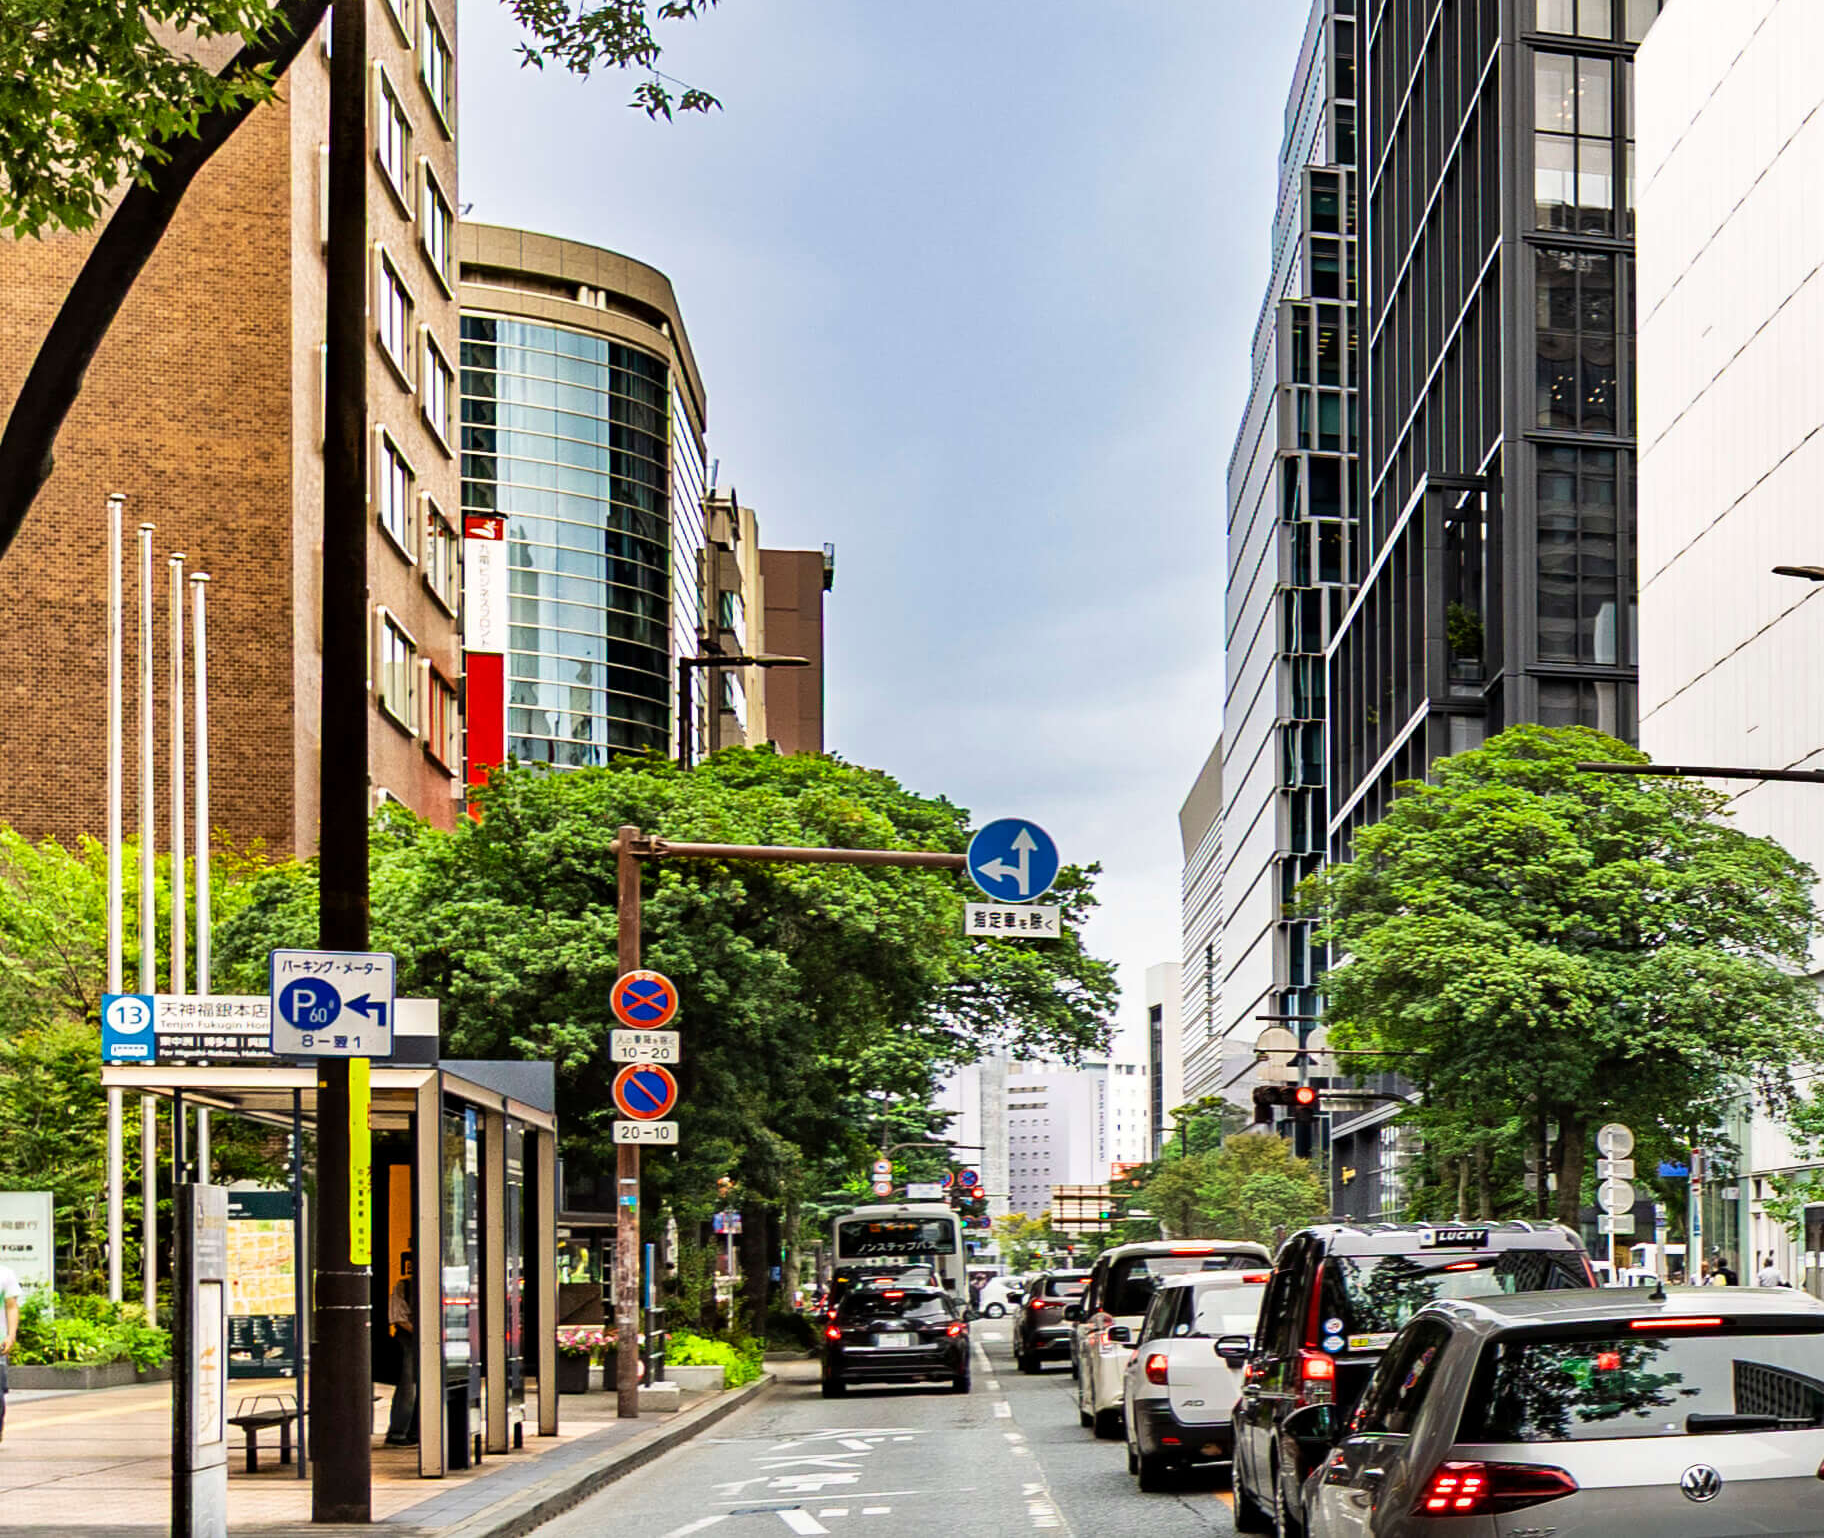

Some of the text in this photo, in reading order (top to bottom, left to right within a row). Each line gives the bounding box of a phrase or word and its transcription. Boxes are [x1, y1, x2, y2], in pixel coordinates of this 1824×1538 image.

[974, 911, 1053, 930] 指定車を除く
[282, 960, 384, 974] パーキング・メーター
[115, 1006, 142, 1024] 13
[160, 1002, 269, 1018] 天神福銀本店
[621, 1047, 670, 1059] 10-20
[622, 1126, 670, 1140] 20-10
[1437, 1229, 1485, 1242] LUCKY
[859, 1241, 938, 1253] ノンステップバス
